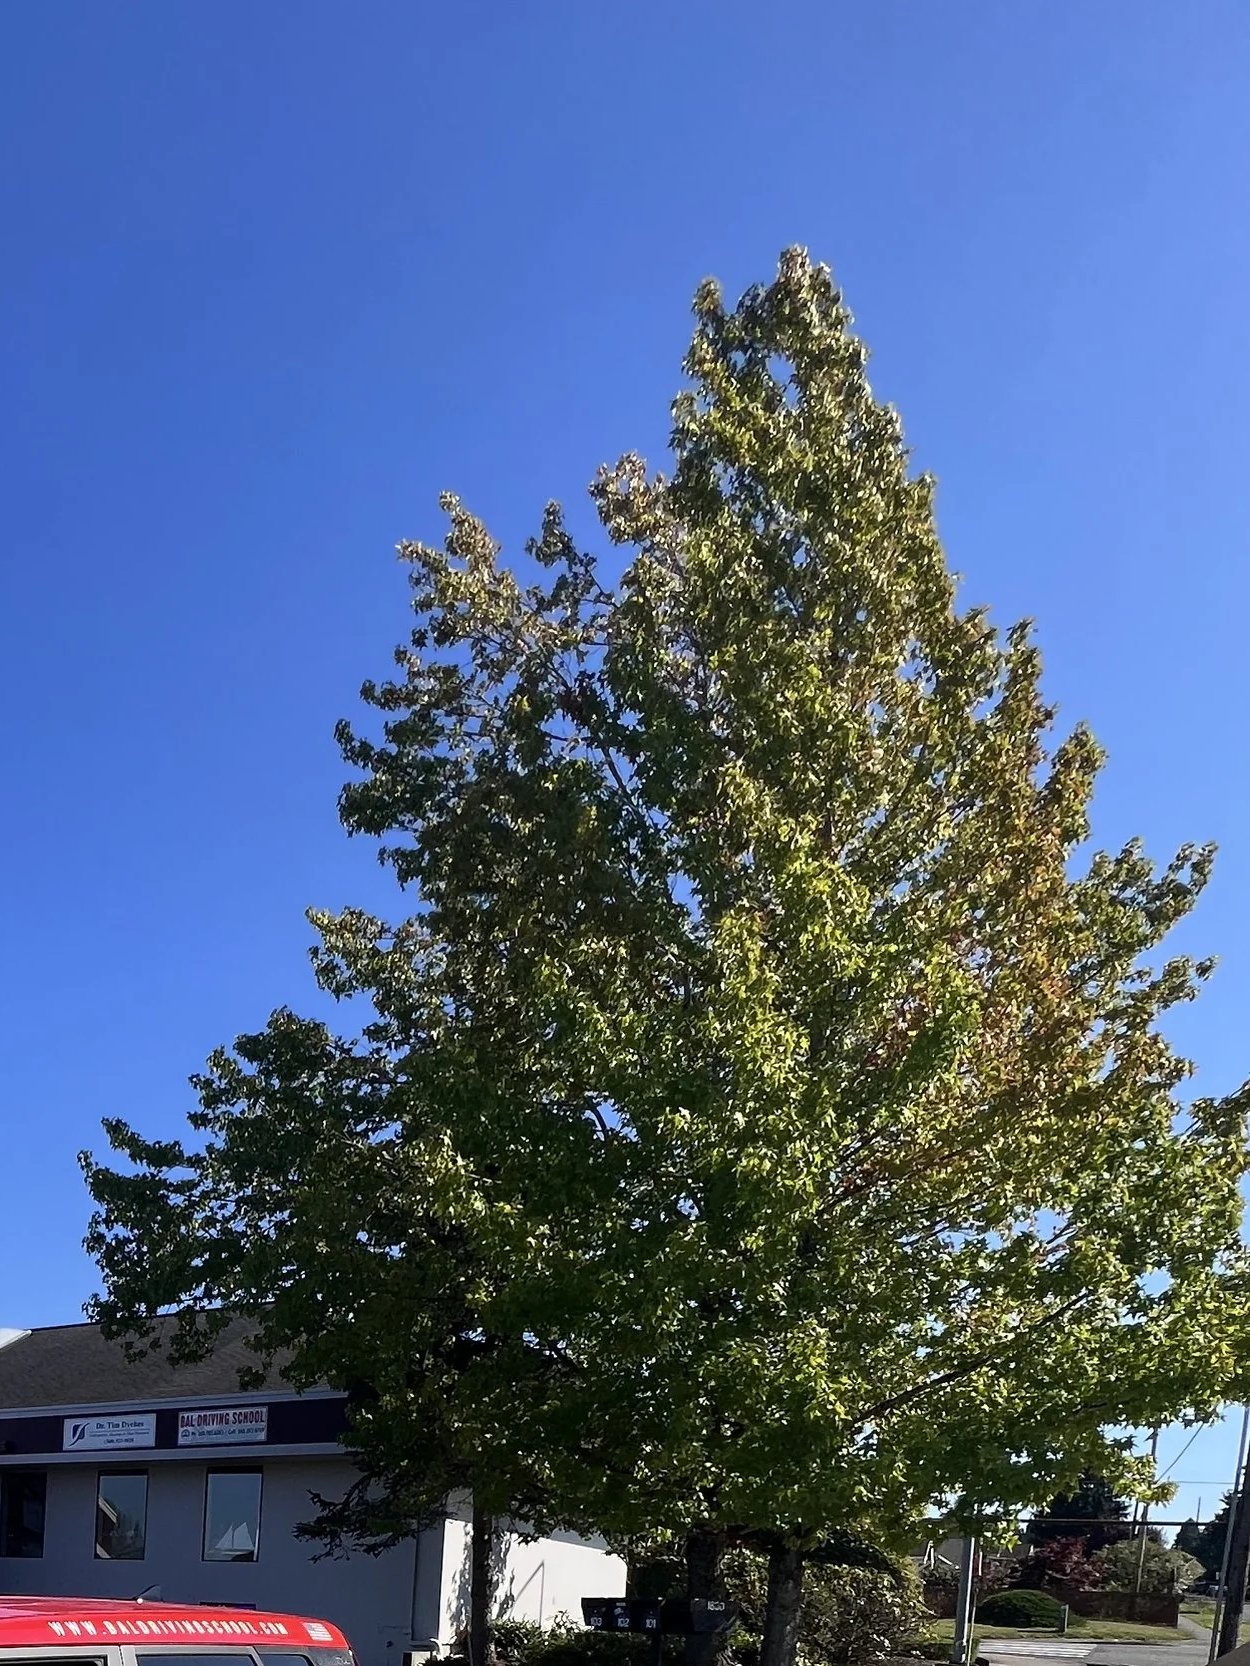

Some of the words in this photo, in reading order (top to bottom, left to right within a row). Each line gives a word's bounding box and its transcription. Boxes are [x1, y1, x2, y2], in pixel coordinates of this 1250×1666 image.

[181, 1415, 195, 1428] BAL
[197, 1413, 229, 1426] DRIVING
[232, 1410, 264, 1424] SCHOOL
